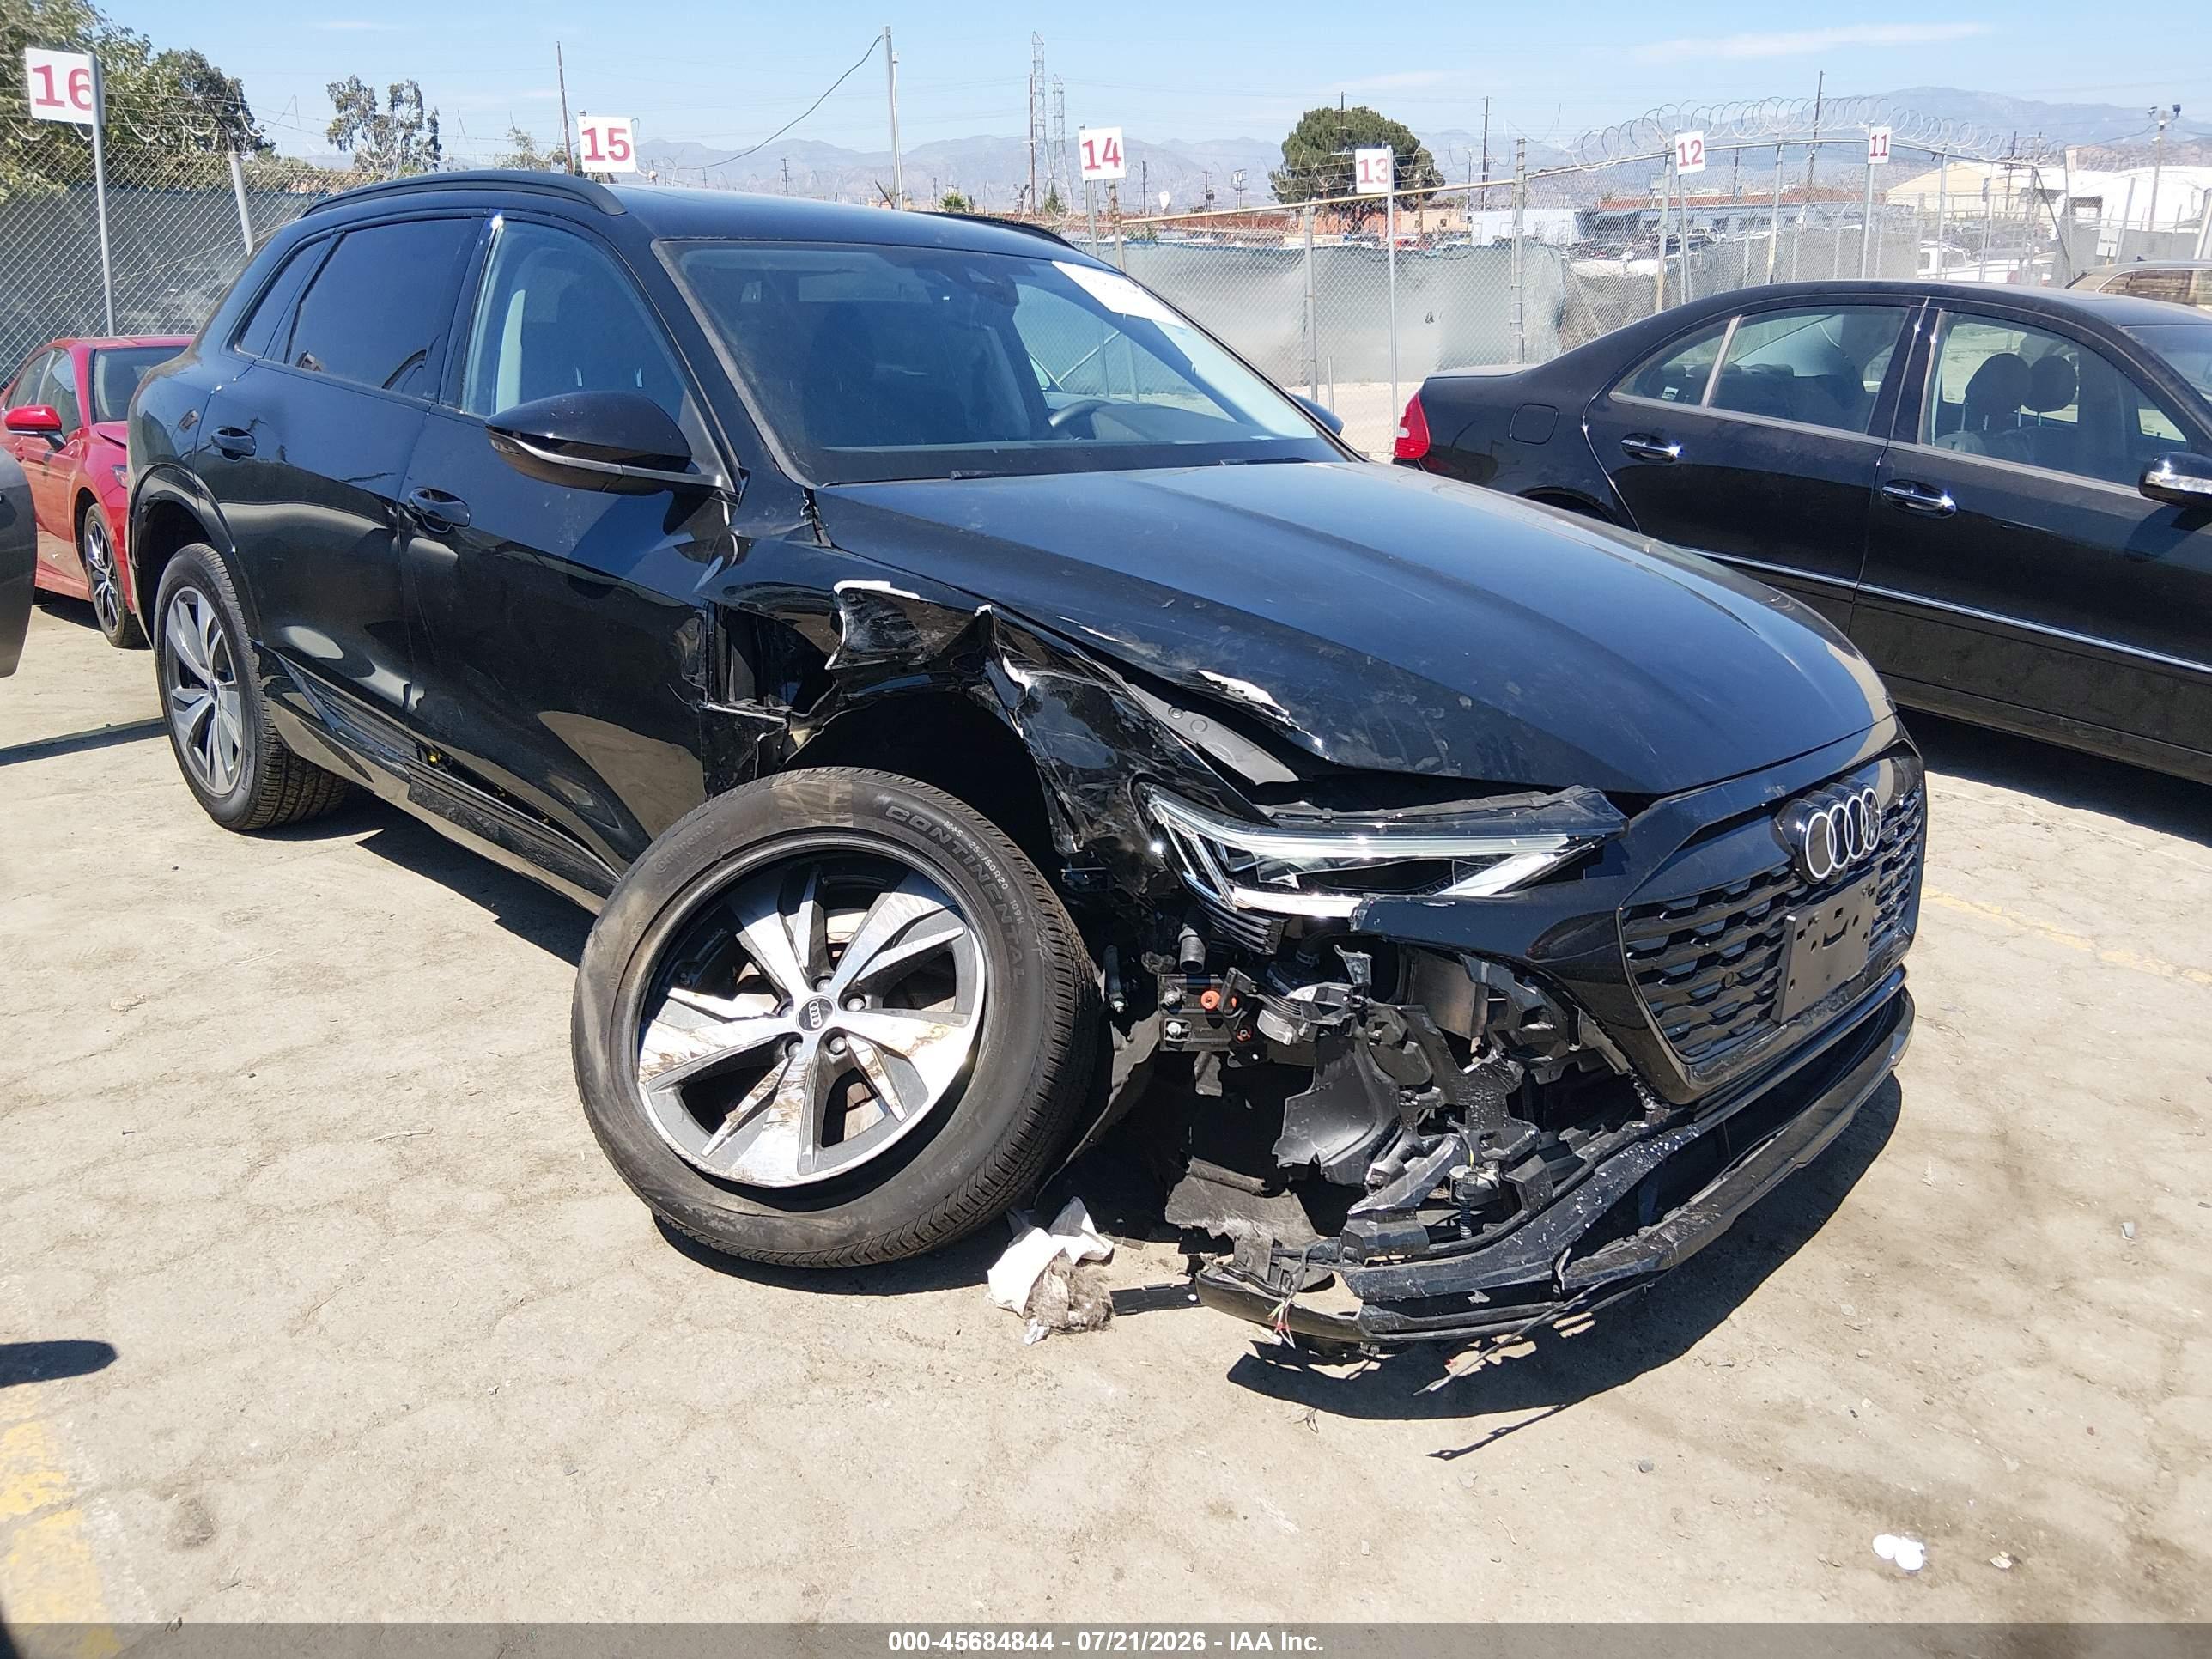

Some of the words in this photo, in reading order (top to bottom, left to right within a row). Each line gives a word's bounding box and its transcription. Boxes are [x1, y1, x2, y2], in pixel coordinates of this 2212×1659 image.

[33, 65, 92, 111] 16
[582, 127, 630, 161] 15
[1082, 137, 1121, 170] 14
[1678, 139, 1703, 167] 12
[1870, 134, 1888, 157] 11
[1358, 158, 1388, 184] 13
[885, 805, 1024, 981] CONTINENTAL
